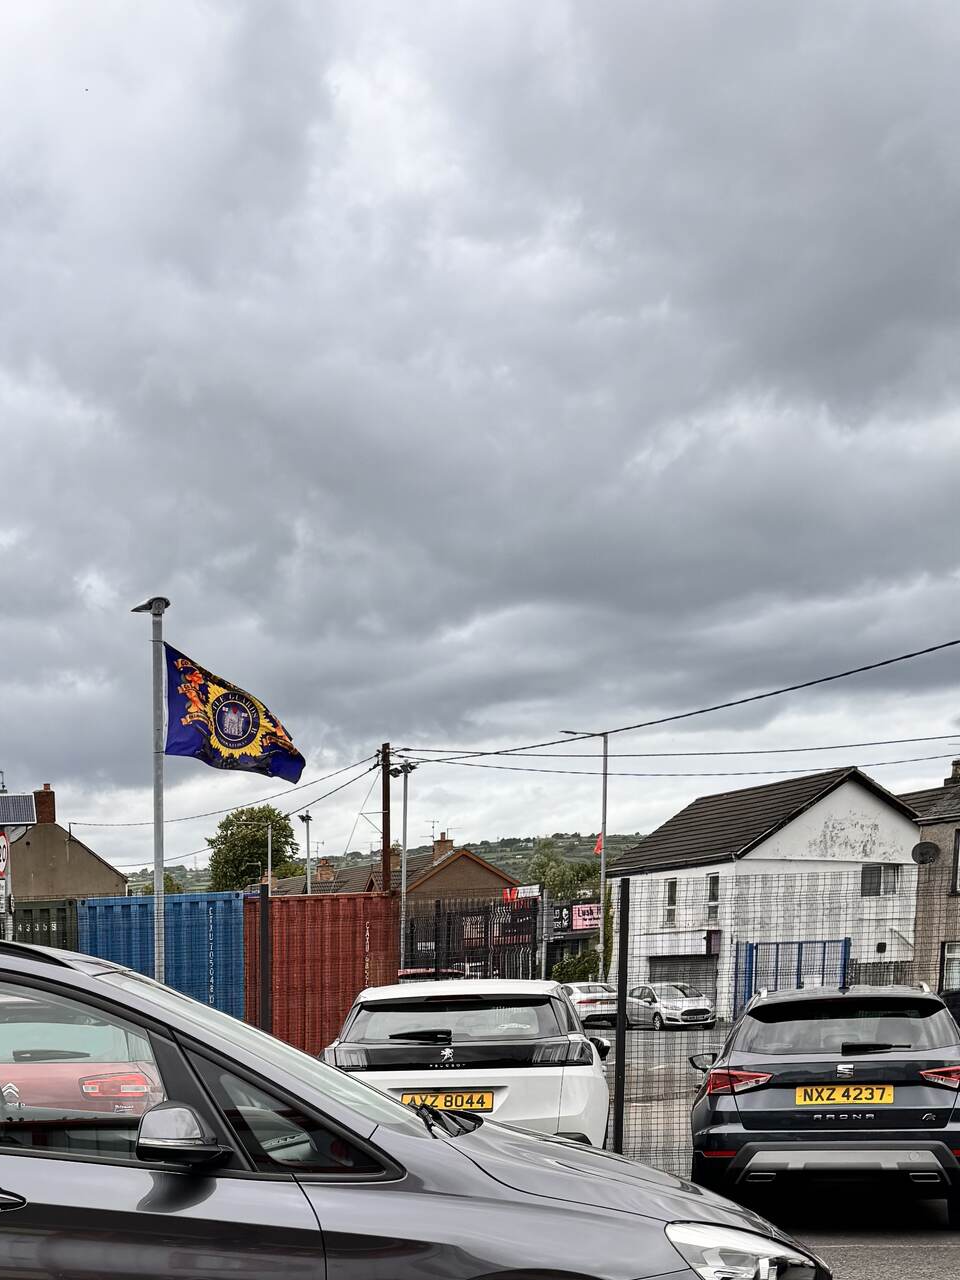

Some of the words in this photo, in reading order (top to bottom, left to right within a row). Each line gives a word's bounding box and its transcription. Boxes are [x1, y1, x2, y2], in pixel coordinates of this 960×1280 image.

[443, 1094, 486, 1108] 8044
[803, 1088, 836, 1102] NXZ
[841, 1087, 886, 1101] 4237
